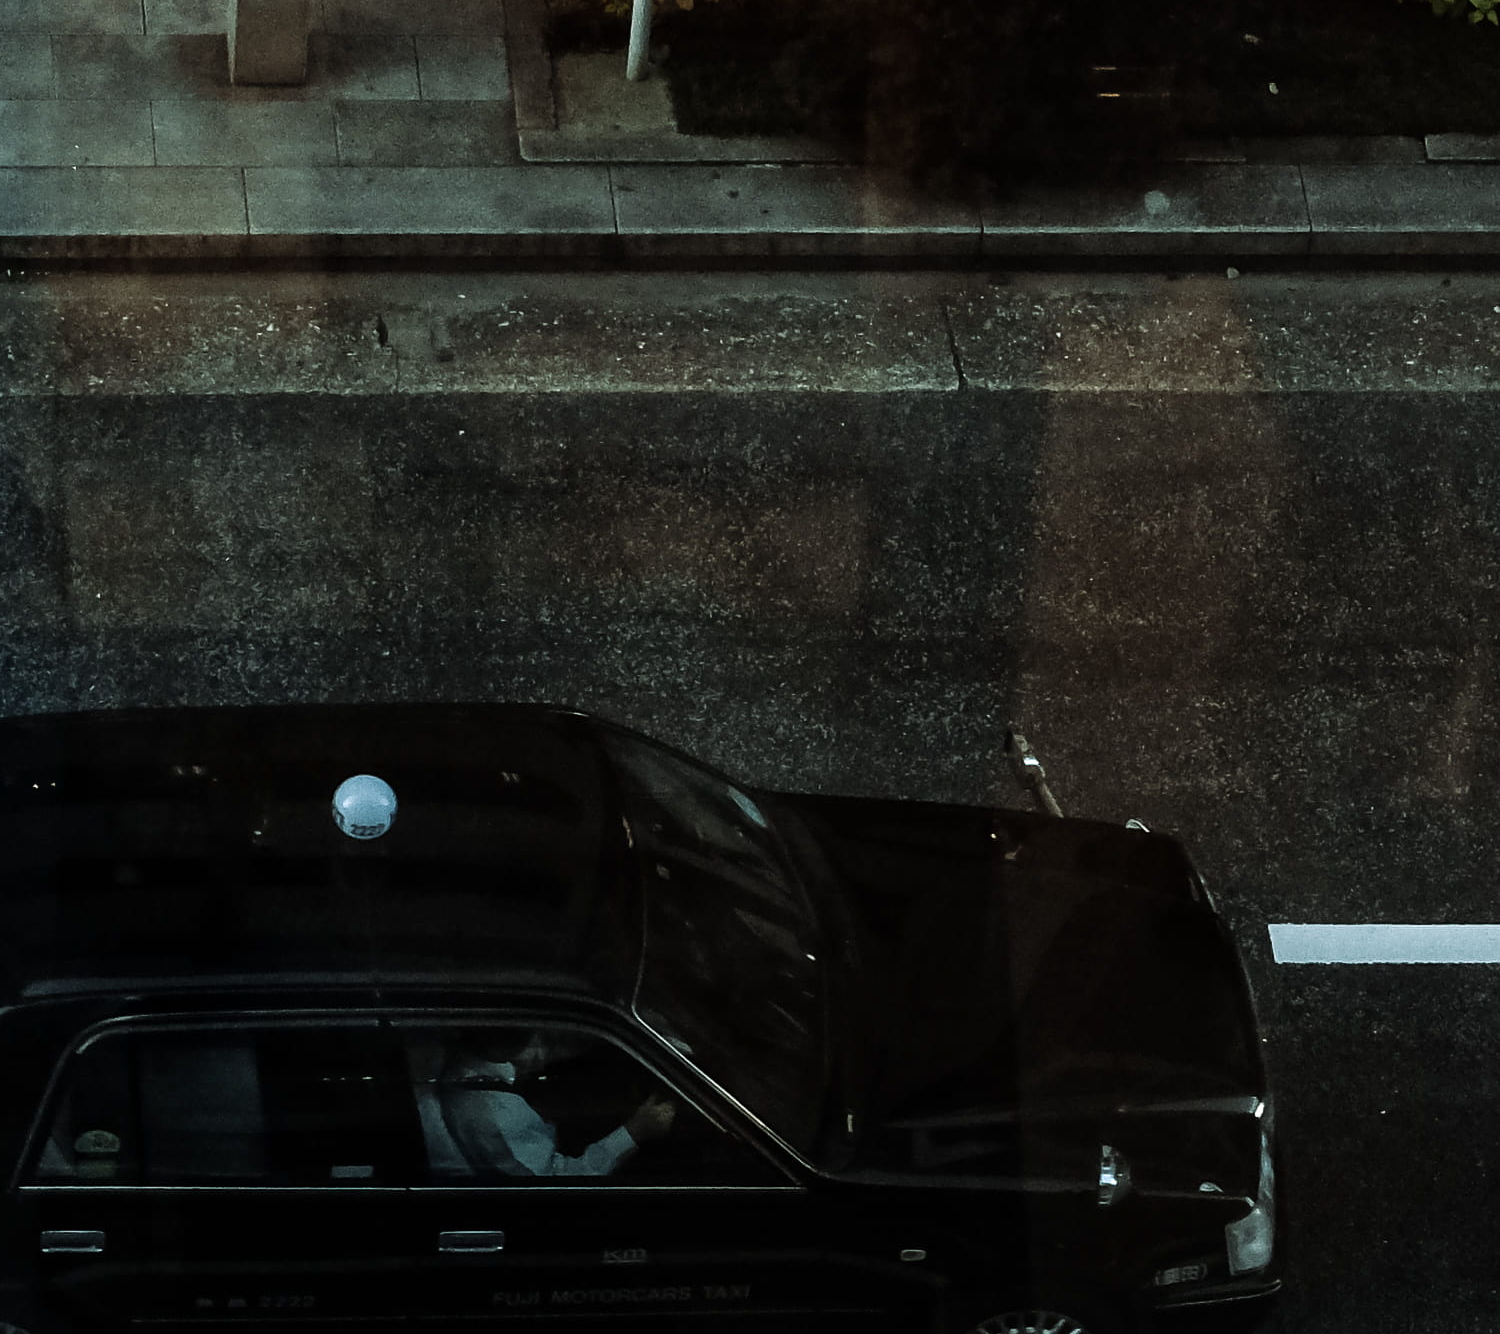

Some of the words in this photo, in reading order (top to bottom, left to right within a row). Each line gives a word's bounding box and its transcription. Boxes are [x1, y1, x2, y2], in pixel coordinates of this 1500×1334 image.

[491, 1291, 540, 1306] FUJI
[550, 1286, 692, 1304] MOTORCARS
[702, 1282, 753, 1299] TAXI
